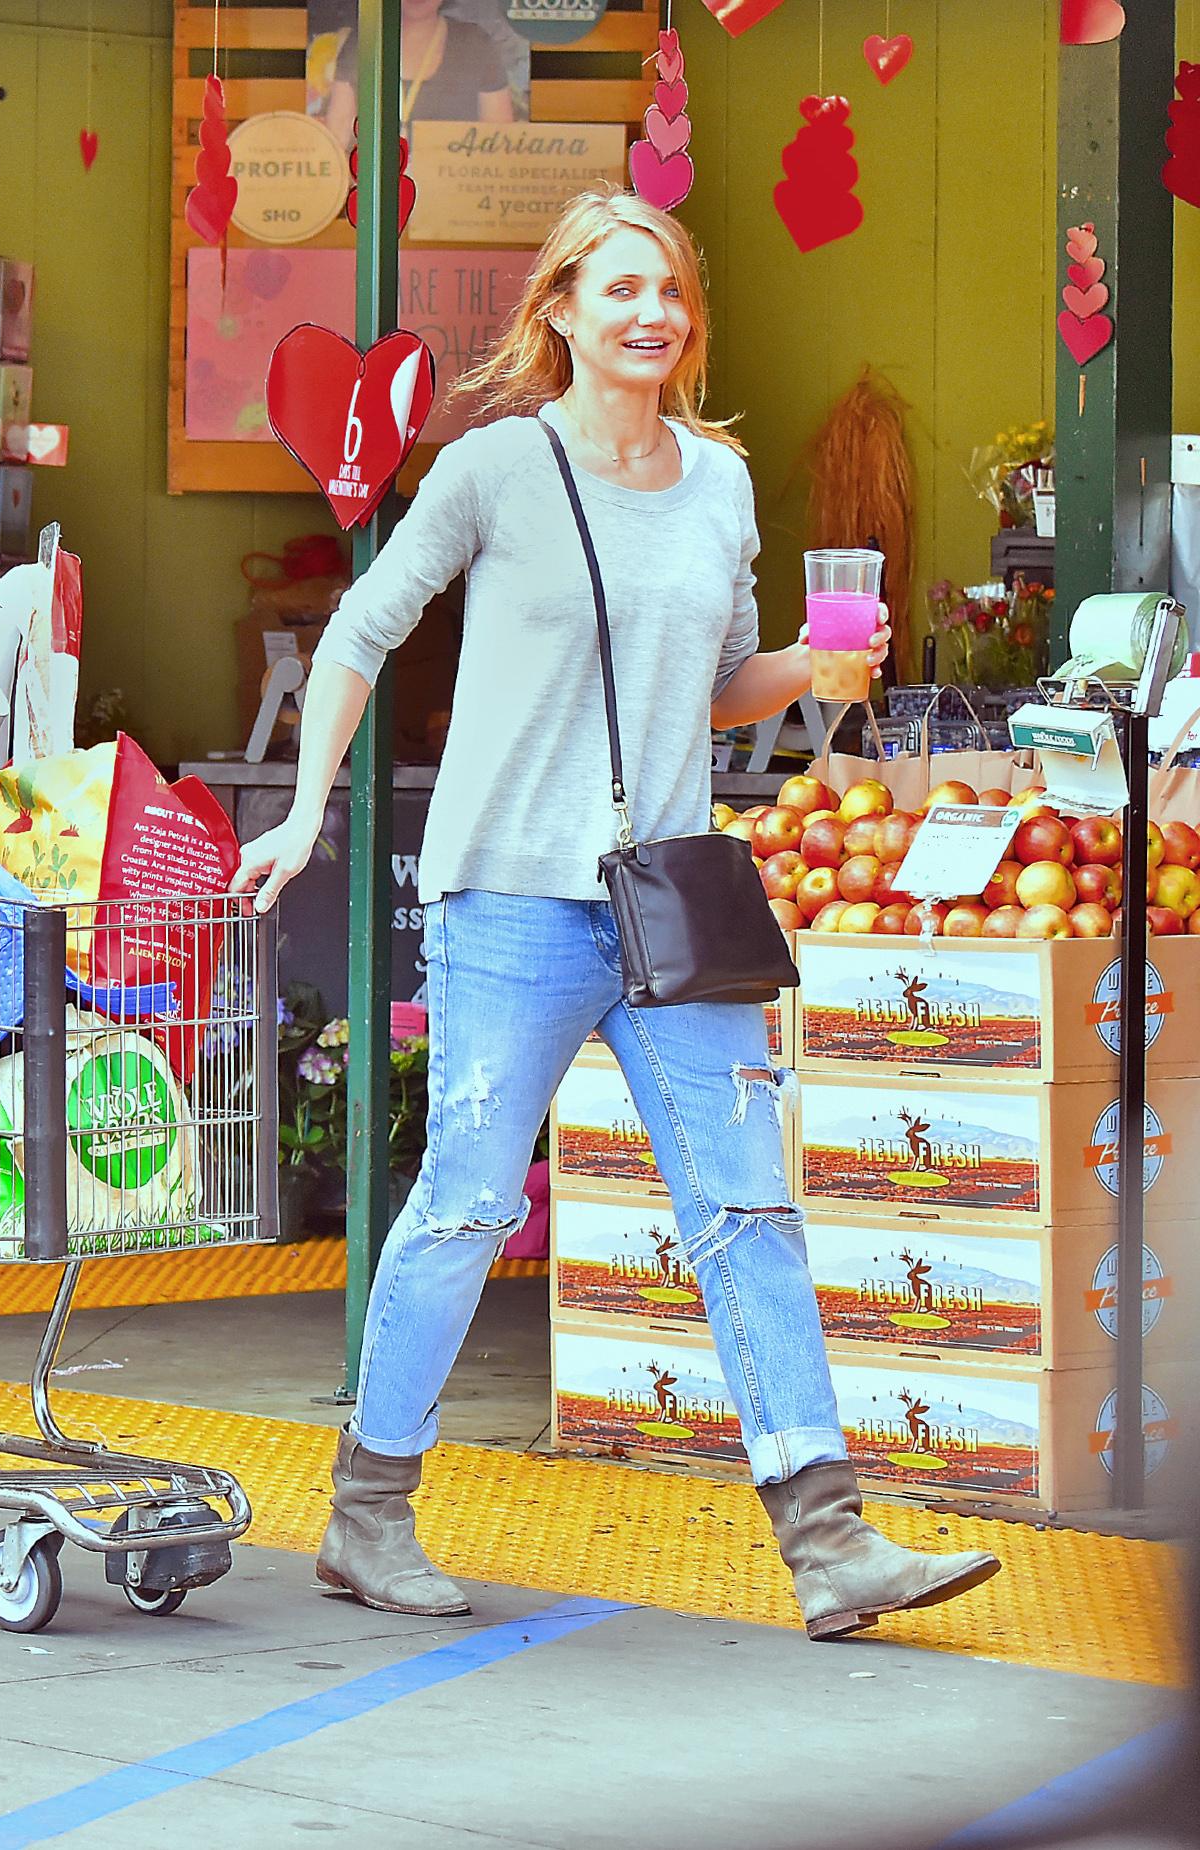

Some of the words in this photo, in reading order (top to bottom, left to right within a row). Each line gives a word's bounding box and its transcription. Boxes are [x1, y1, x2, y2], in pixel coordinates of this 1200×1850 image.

[447, 126, 588, 157] Adriana
[234, 160, 331, 178] PROFILE
[437, 166, 502, 178] FLORAL
[508, 167, 608, 181] SPECIALIST
[262, 208, 301, 222] SHO
[478, 196, 492, 211] 4
[499, 198, 568, 217] years
[454, 268, 499, 316] THE
[343, 378, 364, 464] 6
[143, 804, 175, 820] ABOUT
[176, 812, 194, 825] THE
[935, 811, 985, 823] ORGANIC
[133, 822, 149, 832] Ana
[150, 825, 167, 837] Zaja
[190, 836, 198, 845] is
[140, 834, 172, 849] designer
[171, 844, 186, 853] and
[132, 844, 152, 855] From
[153, 849, 166, 859] her
[166, 852, 189, 866] studio
[189, 859, 197, 868] in
[121, 866, 140, 878] witty
[141, 871, 163, 882] prints
[164, 874, 193, 888] inspired
[194, 882, 202, 893] by
[122, 876, 140, 888] food
[141, 882, 155, 891] and
[150, 860, 166, 871] Ana
[166, 865, 189, 877] makes
[190, 871, 217, 884] colorful
[856, 998, 908, 1025] FIELD
[917, 1000, 981, 1027] FRESH
[609, 1119, 647, 1144] FIEL
[857, 1137, 910, 1165] FIELD
[918, 1141, 982, 1169] FRESH
[609, 1253, 660, 1281] FIELD
[858, 1278, 911, 1306] FIELD
[920, 1282, 984, 1312] FRESH
[607, 1387, 657, 1416] FIELD
[665, 1393, 725, 1424] FRESH
[856, 1417, 909, 1446] FIELD
[918, 1422, 979, 1453] FRESH
